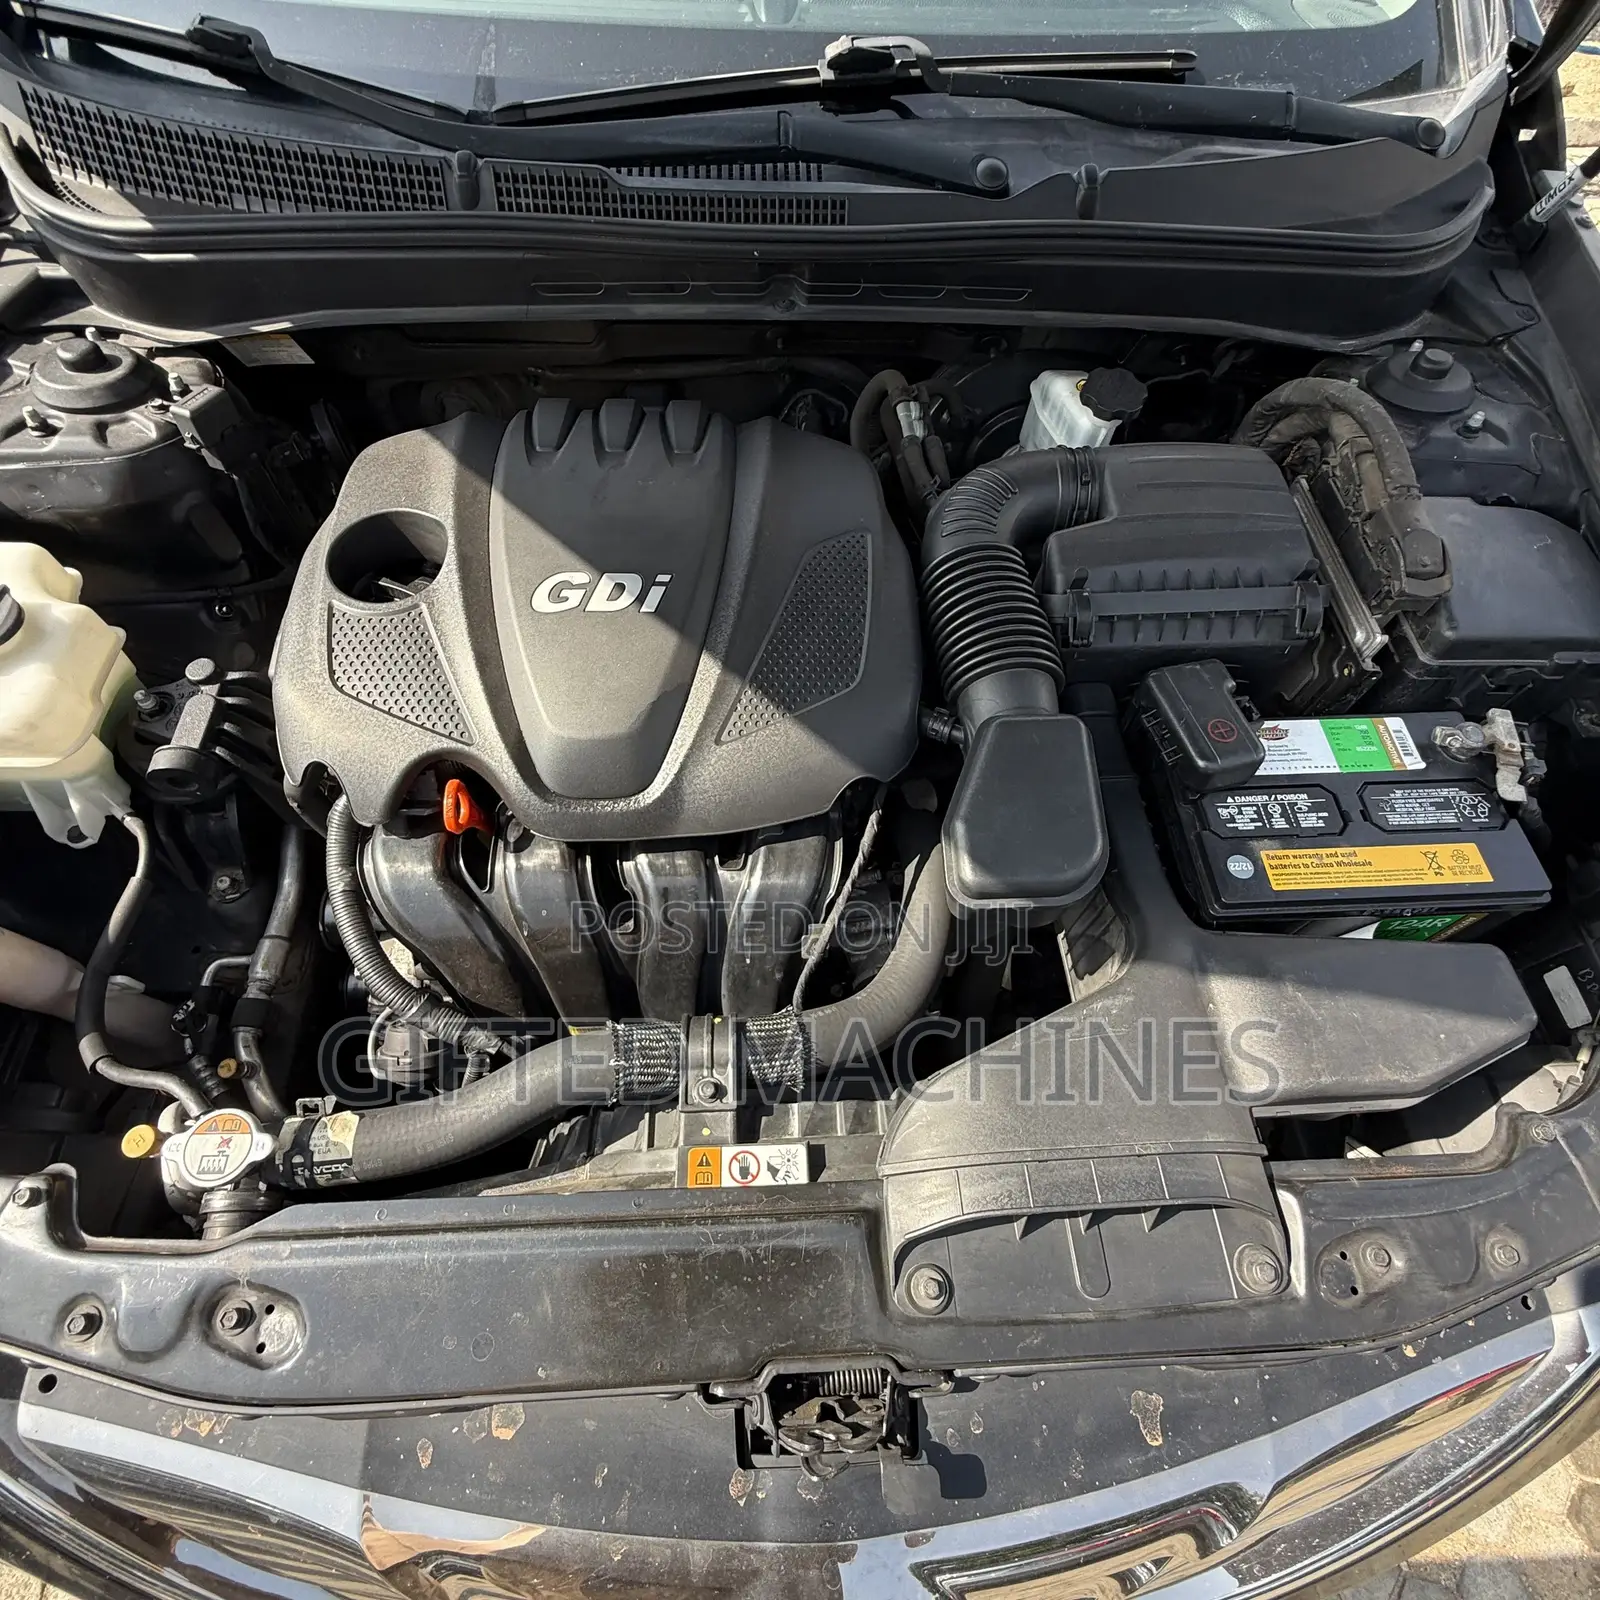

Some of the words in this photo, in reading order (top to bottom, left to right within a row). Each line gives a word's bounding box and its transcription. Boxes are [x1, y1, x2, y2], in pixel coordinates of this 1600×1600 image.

[530, 571, 675, 613] GDi
[1377, 724, 1401, 764] AUTOMOTIVE
[1276, 793, 1308, 801] POISON
[1265, 852, 1290, 861] Return
[1291, 852, 1323, 863] warranty
[1325, 850, 1339, 859] and
[1340, 850, 1358, 858] used
[1229, 861, 1253, 871] 12/22
[1269, 861, 1301, 870] batteries
[1303, 861, 1310, 869] to
[1310, 860, 1334, 869] Costco
[1335, 859, 1373, 868] Wholesale
[1387, 917, 1452, 930] 124R
